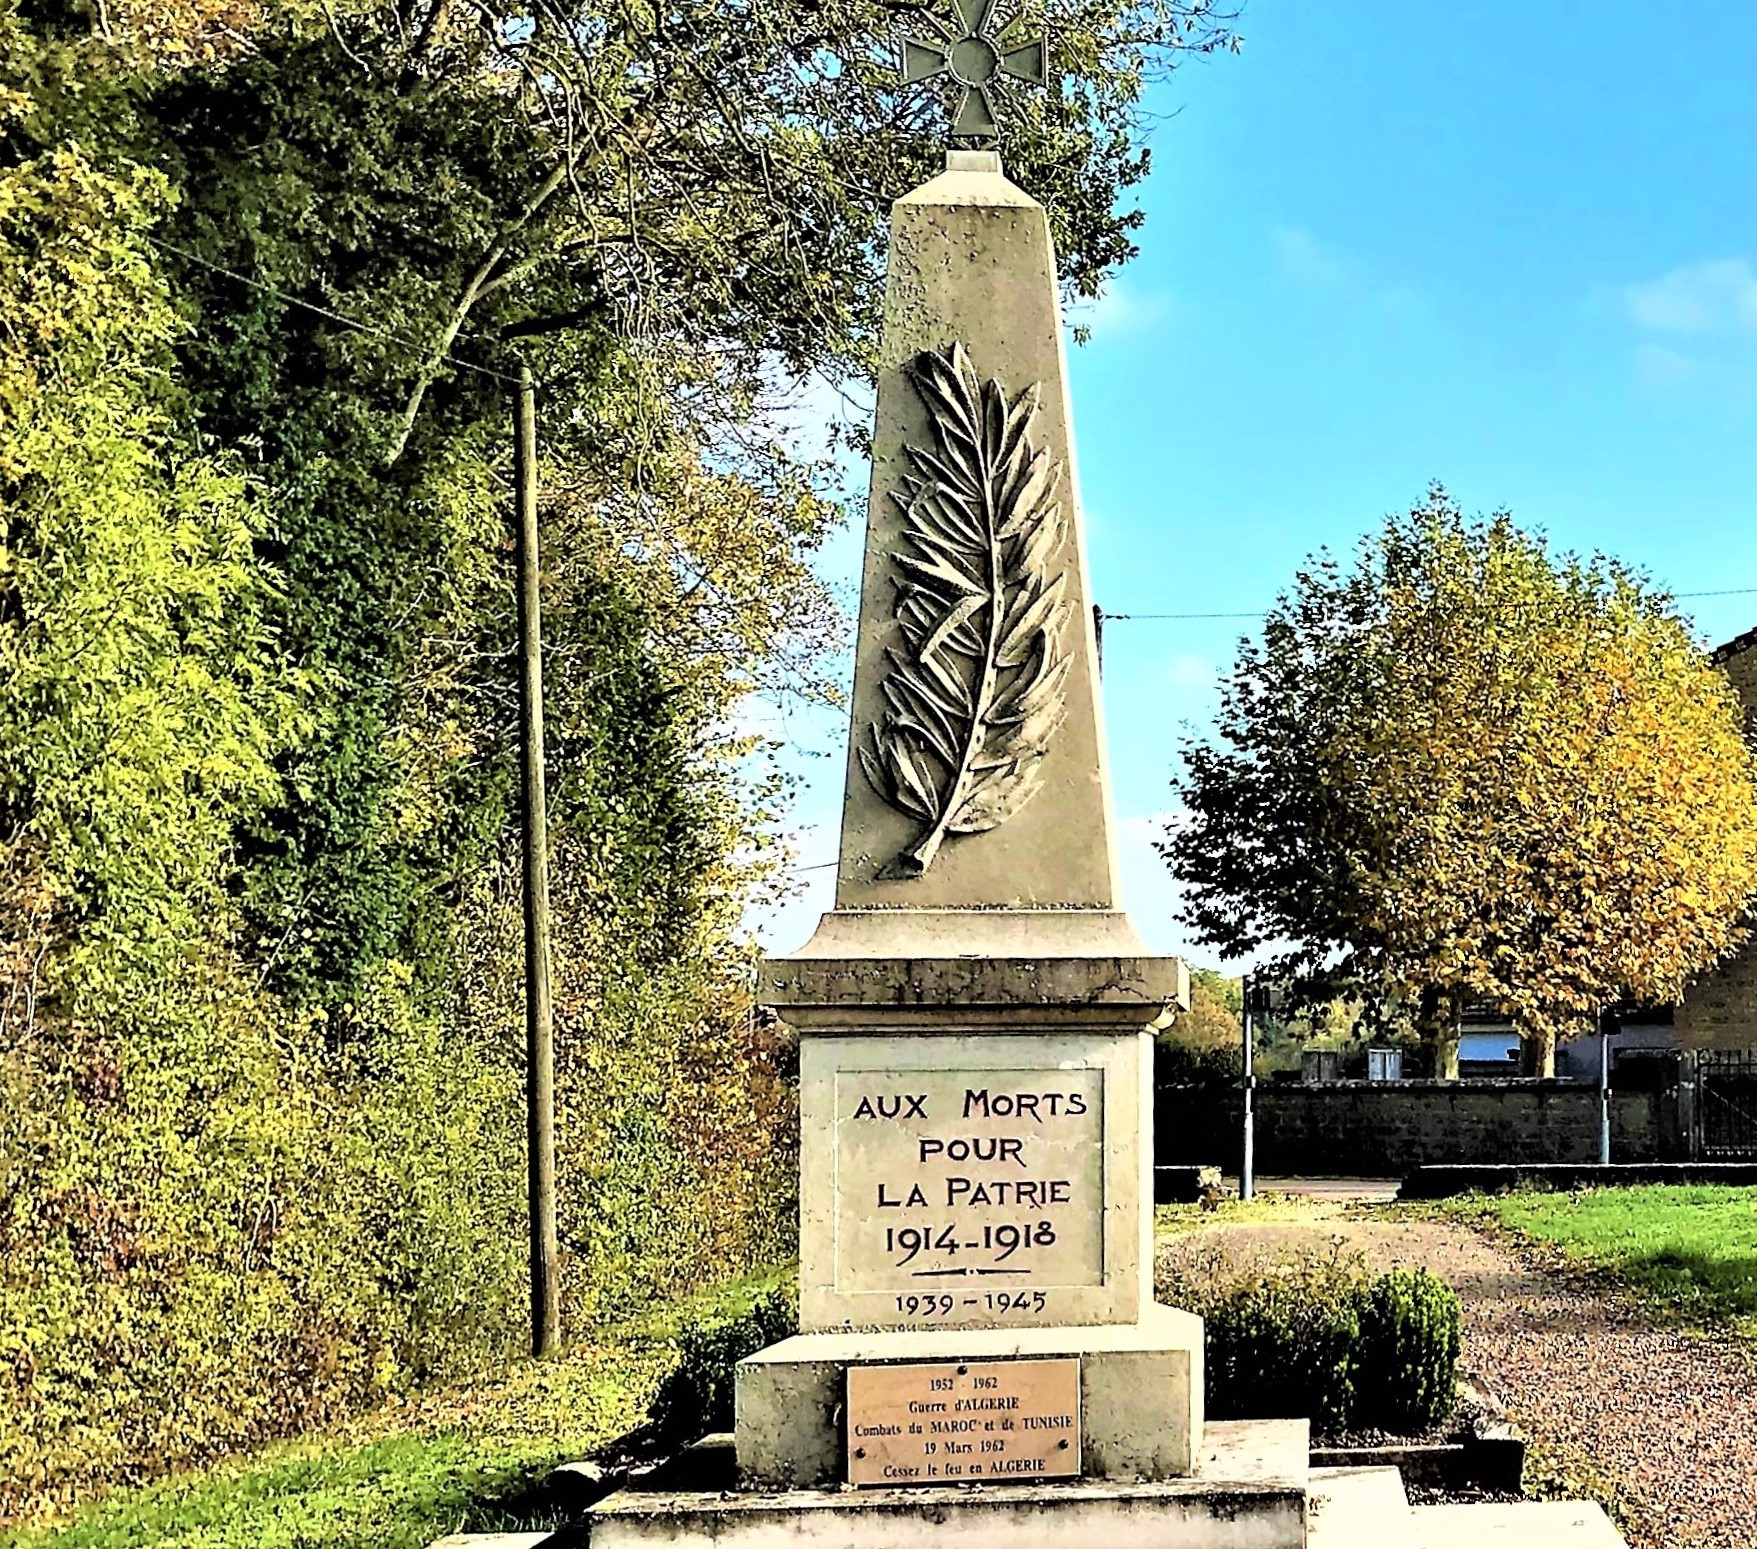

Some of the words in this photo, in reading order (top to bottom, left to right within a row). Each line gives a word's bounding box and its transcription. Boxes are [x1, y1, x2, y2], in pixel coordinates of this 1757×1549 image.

[853, 1094, 928, 1119] AUX
[962, 1089, 1087, 1123] MORTS
[919, 1138, 1027, 1167] POUR
[878, 1183, 928, 1208] LA
[946, 1177, 1071, 1209] PATRIE
[886, 1220, 1056, 1267] 1914-1918
[896, 1292, 954, 1315] 1939
[986, 1291, 1047, 1314] 1945
[930, 1378, 954, 1391] 1952
[973, 1377, 998, 1389] 1962
[909, 1400, 947, 1414] Guerre
[955, 1397, 1019, 1411] d'ALGERIE
[855, 1423, 902, 1437] Combats
[909, 1422, 923, 1434] du
[930, 1419, 977, 1433] MAROC
[984, 1420, 994, 1431] et
[1002, 1418, 1015, 1431] de
[1022, 1415, 1073, 1430] TUNISIE
[924, 1442, 936, 1455] 19
[944, 1441, 973, 1454] Mars
[980, 1440, 1005, 1452] 1962
[884, 1464, 920, 1478] Cessez
[927, 1463, 938, 1476] le
[945, 1462, 962, 1475] feu
[969, 1464, 982, 1474] en
[989, 1459, 1045, 1473] ALGERIE
